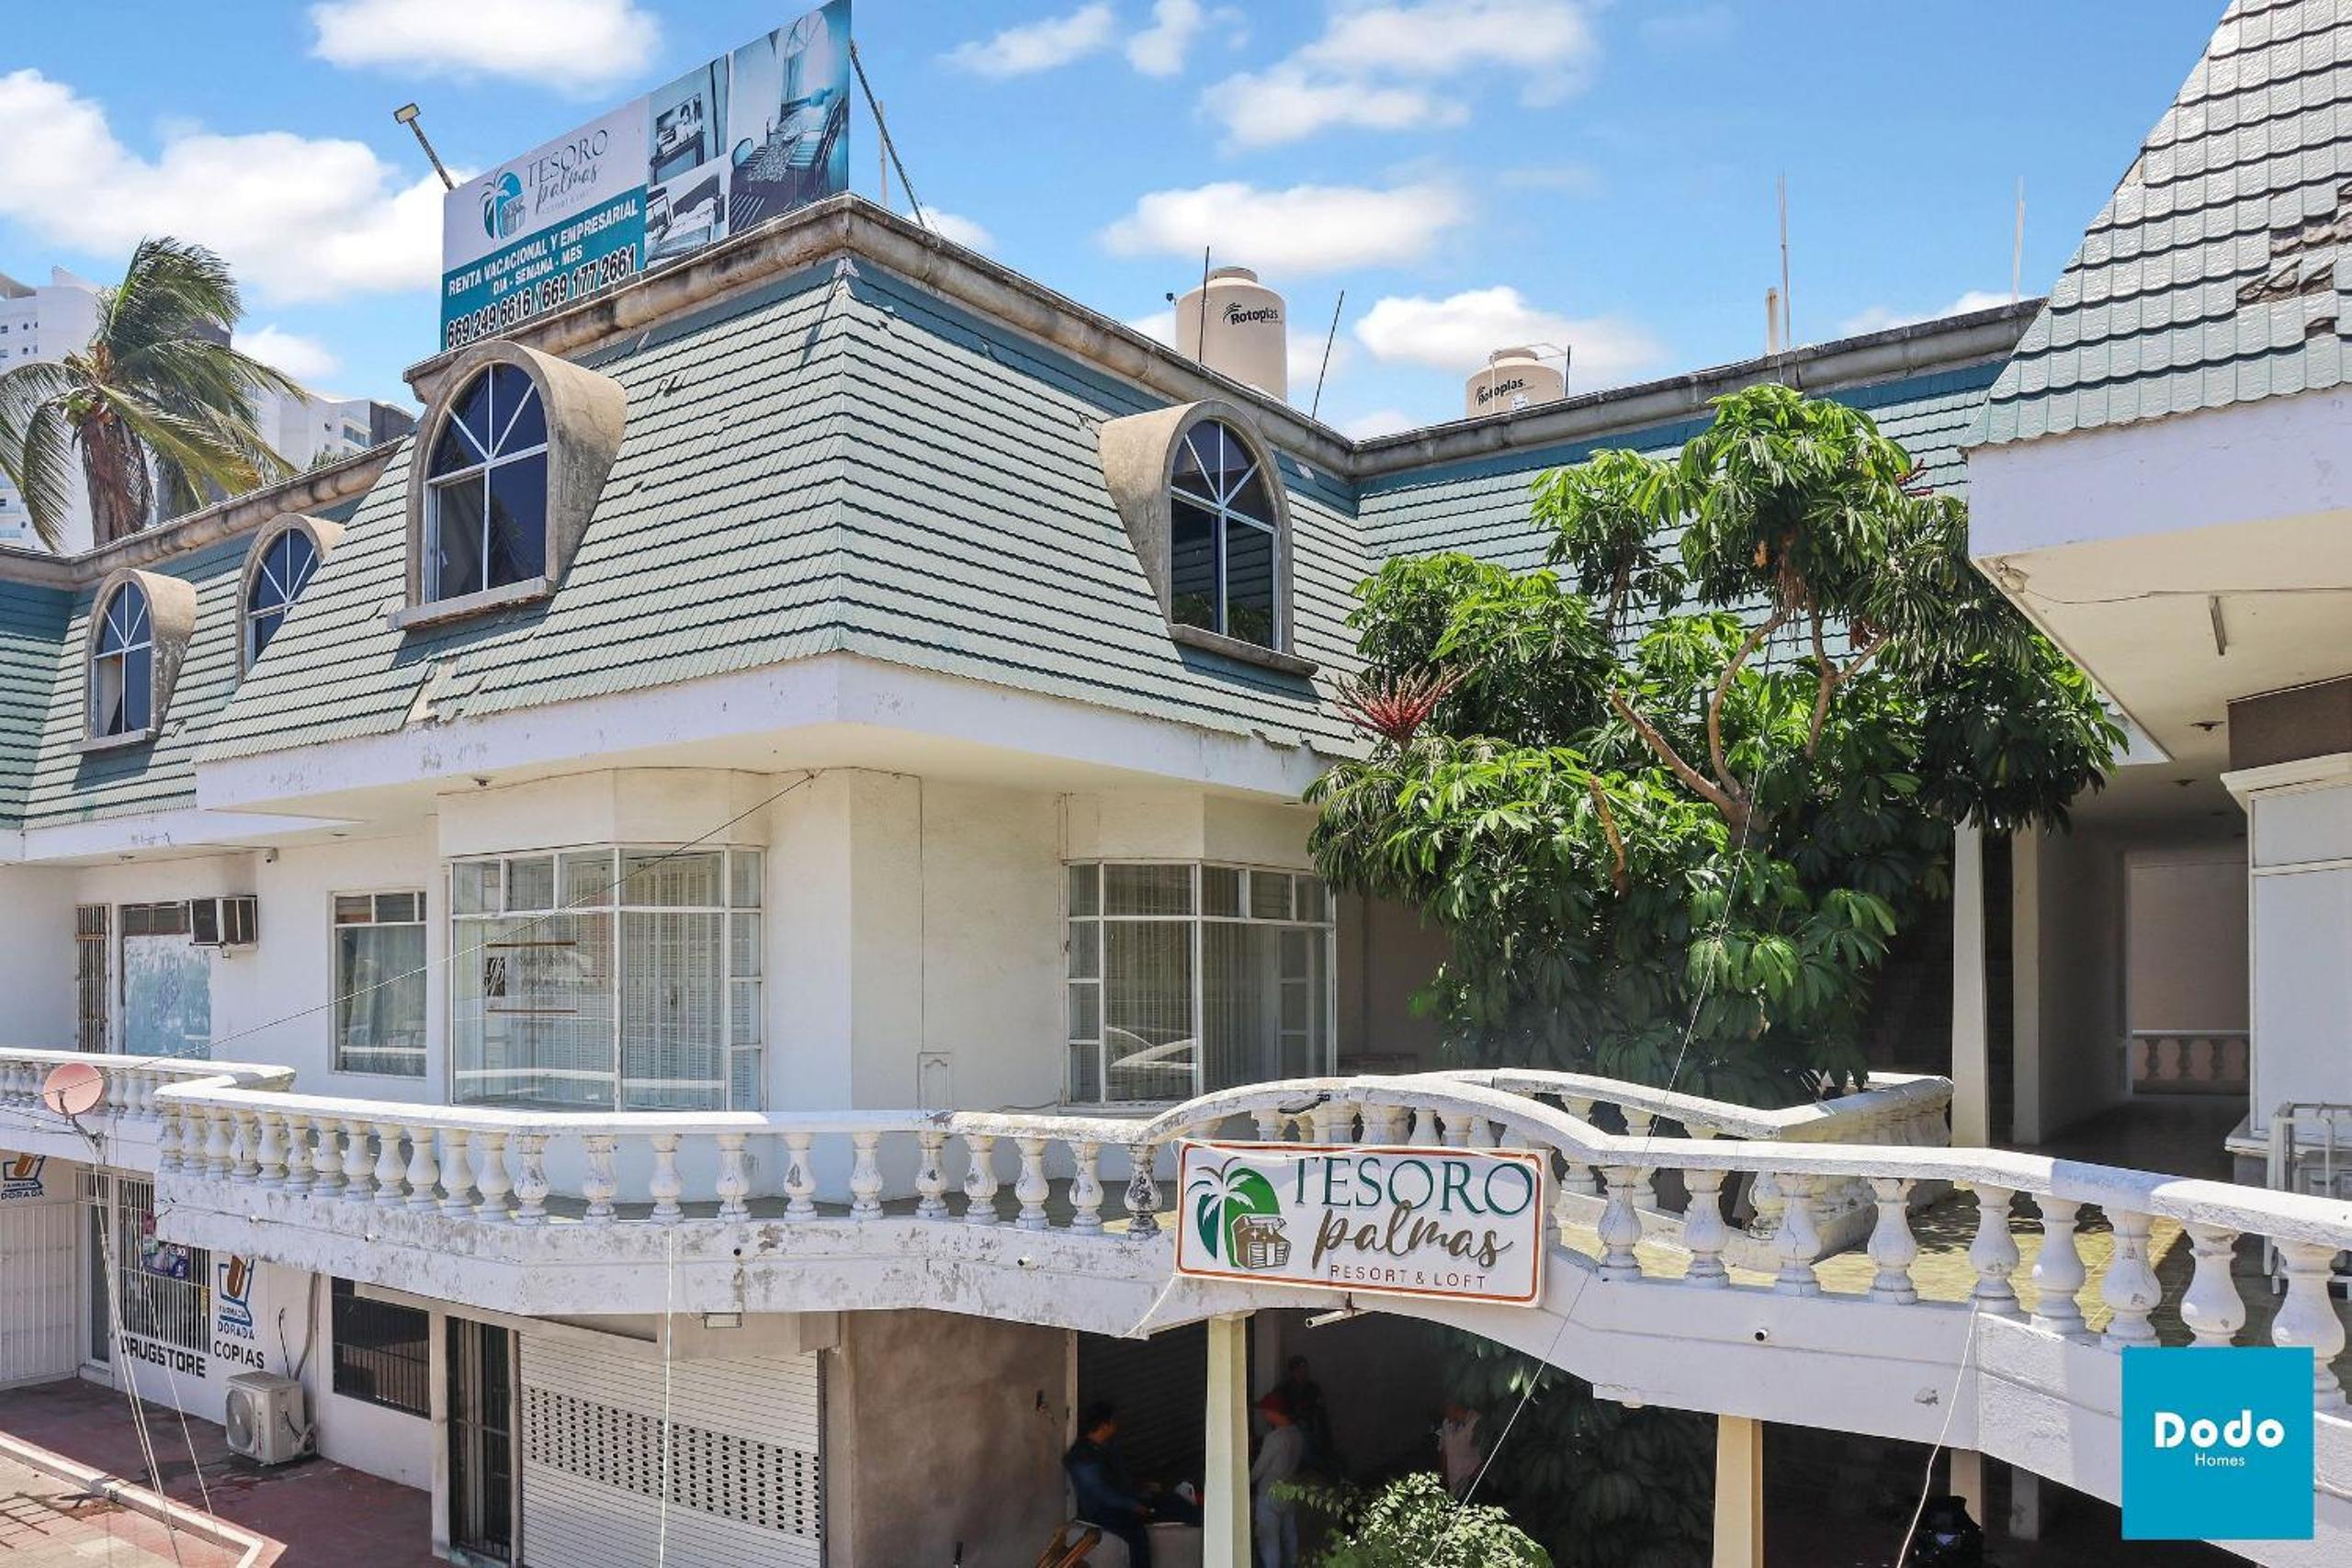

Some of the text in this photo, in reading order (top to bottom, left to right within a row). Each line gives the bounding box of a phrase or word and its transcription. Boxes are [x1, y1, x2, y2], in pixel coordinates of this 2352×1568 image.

[527, 130, 607, 187] TESORO
[536, 164, 597, 214] palmas
[448, 267, 482, 297] RENTA
[484, 239, 548, 281] VACACIONAL
[550, 233, 559, 251] Y
[560, 198, 639, 247] EMPRESARIAL
[515, 257, 554, 285] SEMANA
[561, 244, 583, 265] MES
[447, 313, 471, 350] 669
[499, 286, 533, 327] 6616
[541, 273, 568, 310] 669
[573, 259, 598, 299] 177
[600, 243, 636, 288] 2661
[1231, 307, 1279, 325] Rotoplas
[1477, 378, 1523, 406] Rotoplas
[1288, 1156, 1533, 1216] TESORO
[1312, 1199, 1514, 1269] palmas
[1330, 1264, 1487, 1288] RESORT & LOFT
[218, 1321, 254, 1340] DORADA
[121, 1336, 207, 1379] DRUGSTORE
[214, 1340, 265, 1370] COPIAS
